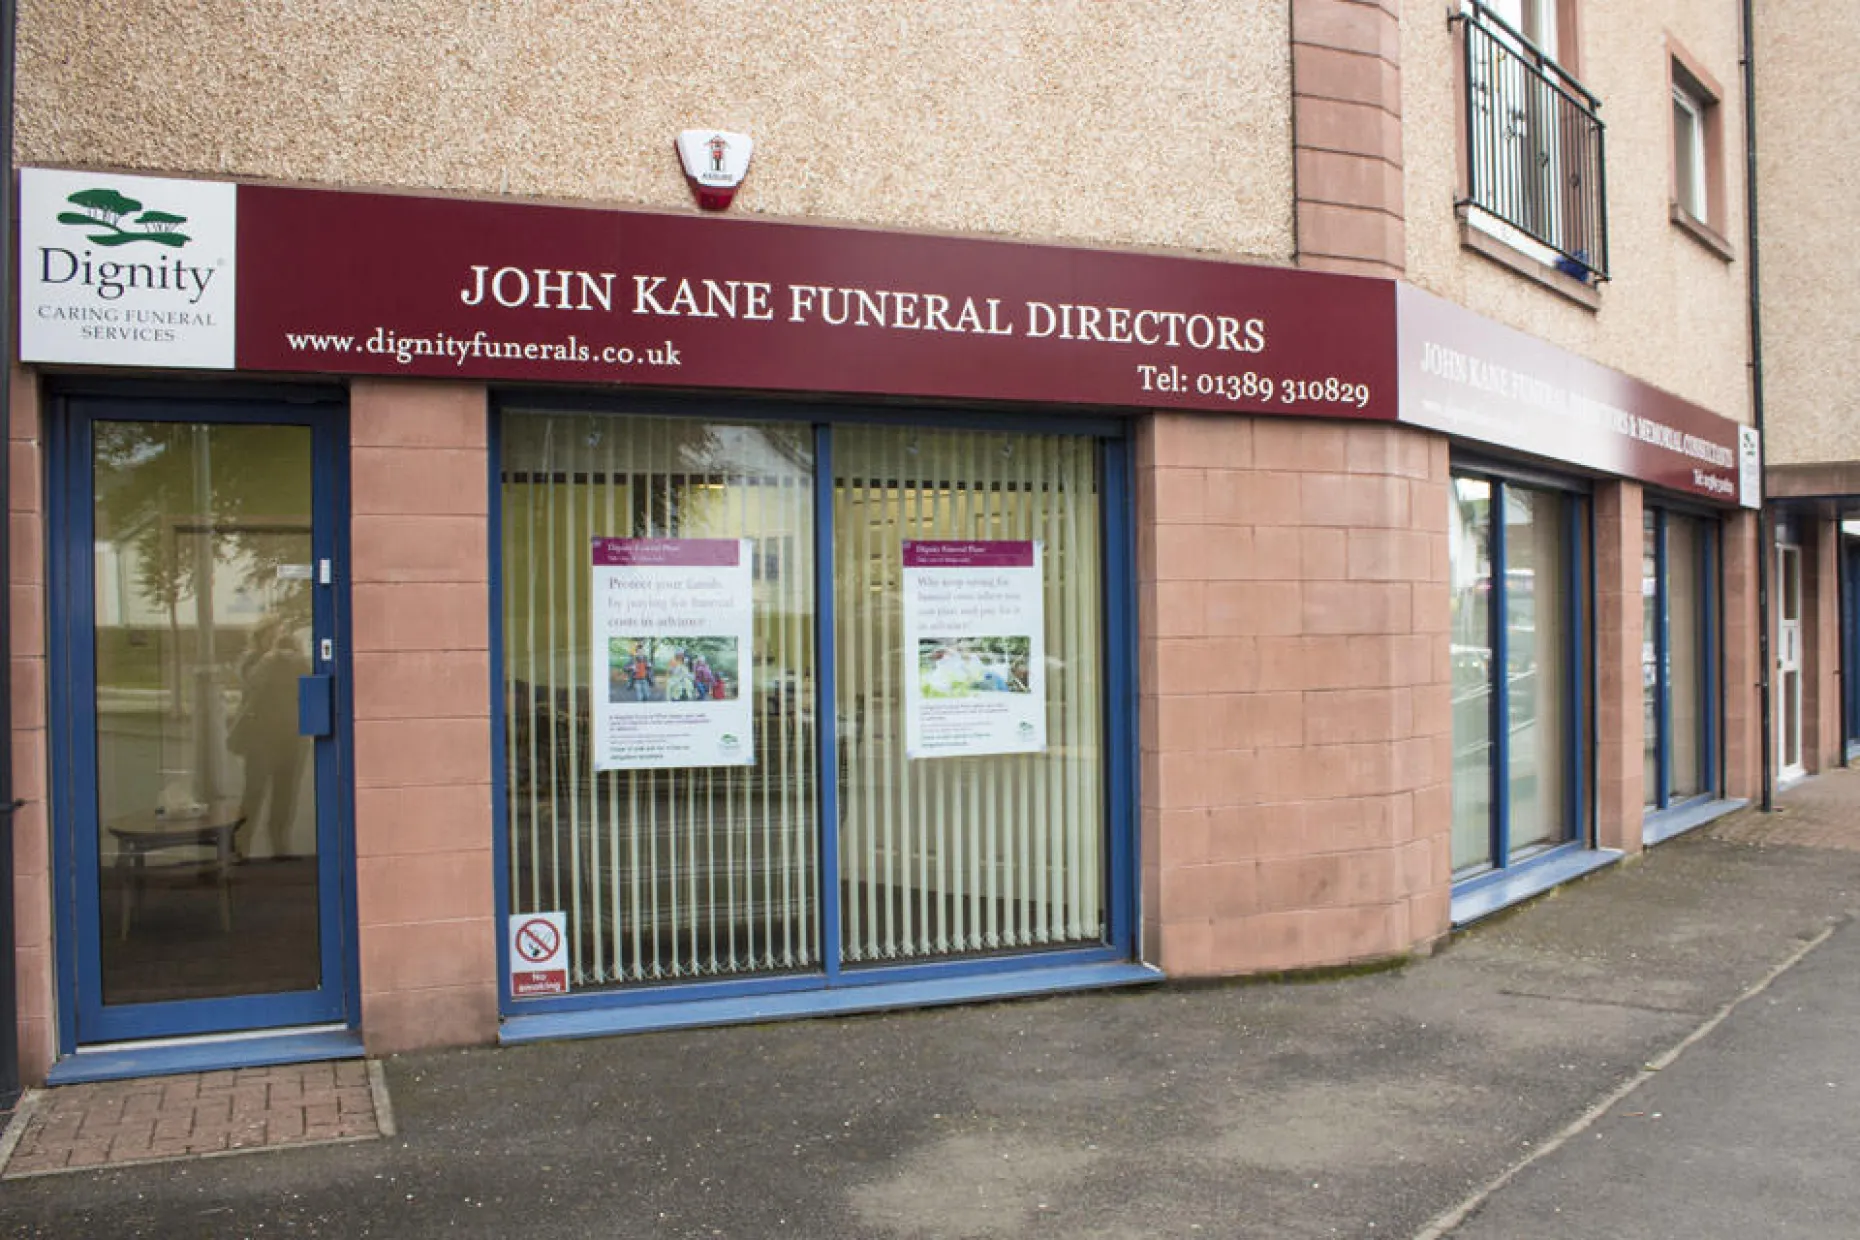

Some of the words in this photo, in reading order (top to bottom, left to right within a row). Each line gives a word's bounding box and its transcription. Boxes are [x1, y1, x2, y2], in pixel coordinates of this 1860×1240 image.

[40, 245, 215, 304] Dignity
[38, 305, 120, 325] CARING
[125, 308, 217, 327] FUNERAL
[460, 265, 617, 311] JOHN
[632, 274, 774, 322] KANE
[788, 284, 1014, 338] FUNERAL
[1025, 301, 1266, 354] DIRECTORS
[81, 325, 175, 342] SERVICES
[286, 325, 682, 365] www.dignityfunerals.co.uk
[1421, 341, 1467, 384] JOHN
[1136, 363, 1188, 394] Tel:
[1196, 371, 1274, 402] 01389
[1280, 377, 1369, 409] 310829
